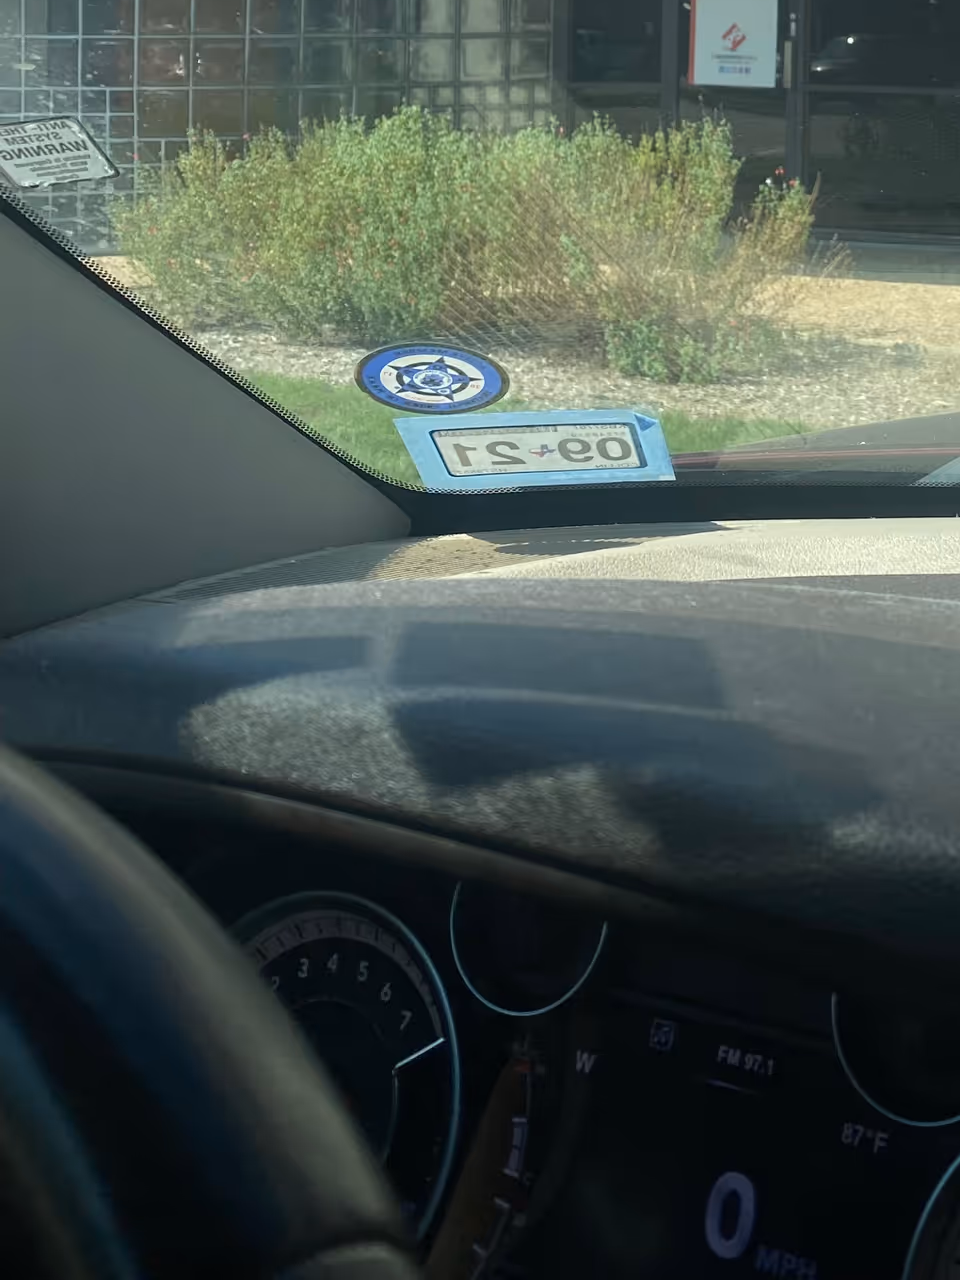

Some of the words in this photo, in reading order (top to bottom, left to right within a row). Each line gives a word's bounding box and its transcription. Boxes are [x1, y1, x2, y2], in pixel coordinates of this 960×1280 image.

[297, 958, 309, 979] 3
[326, 953, 339, 974] 4
[357, 961, 370, 982] 5
[380, 982, 393, 1002] 6
[399, 1010, 413, 1032] 7
[575, 1049, 597, 1074] W
[716, 1044, 741, 1067] FM
[743, 1052, 776, 1076] 97.1
[704, 1170, 757, 1261] 0
